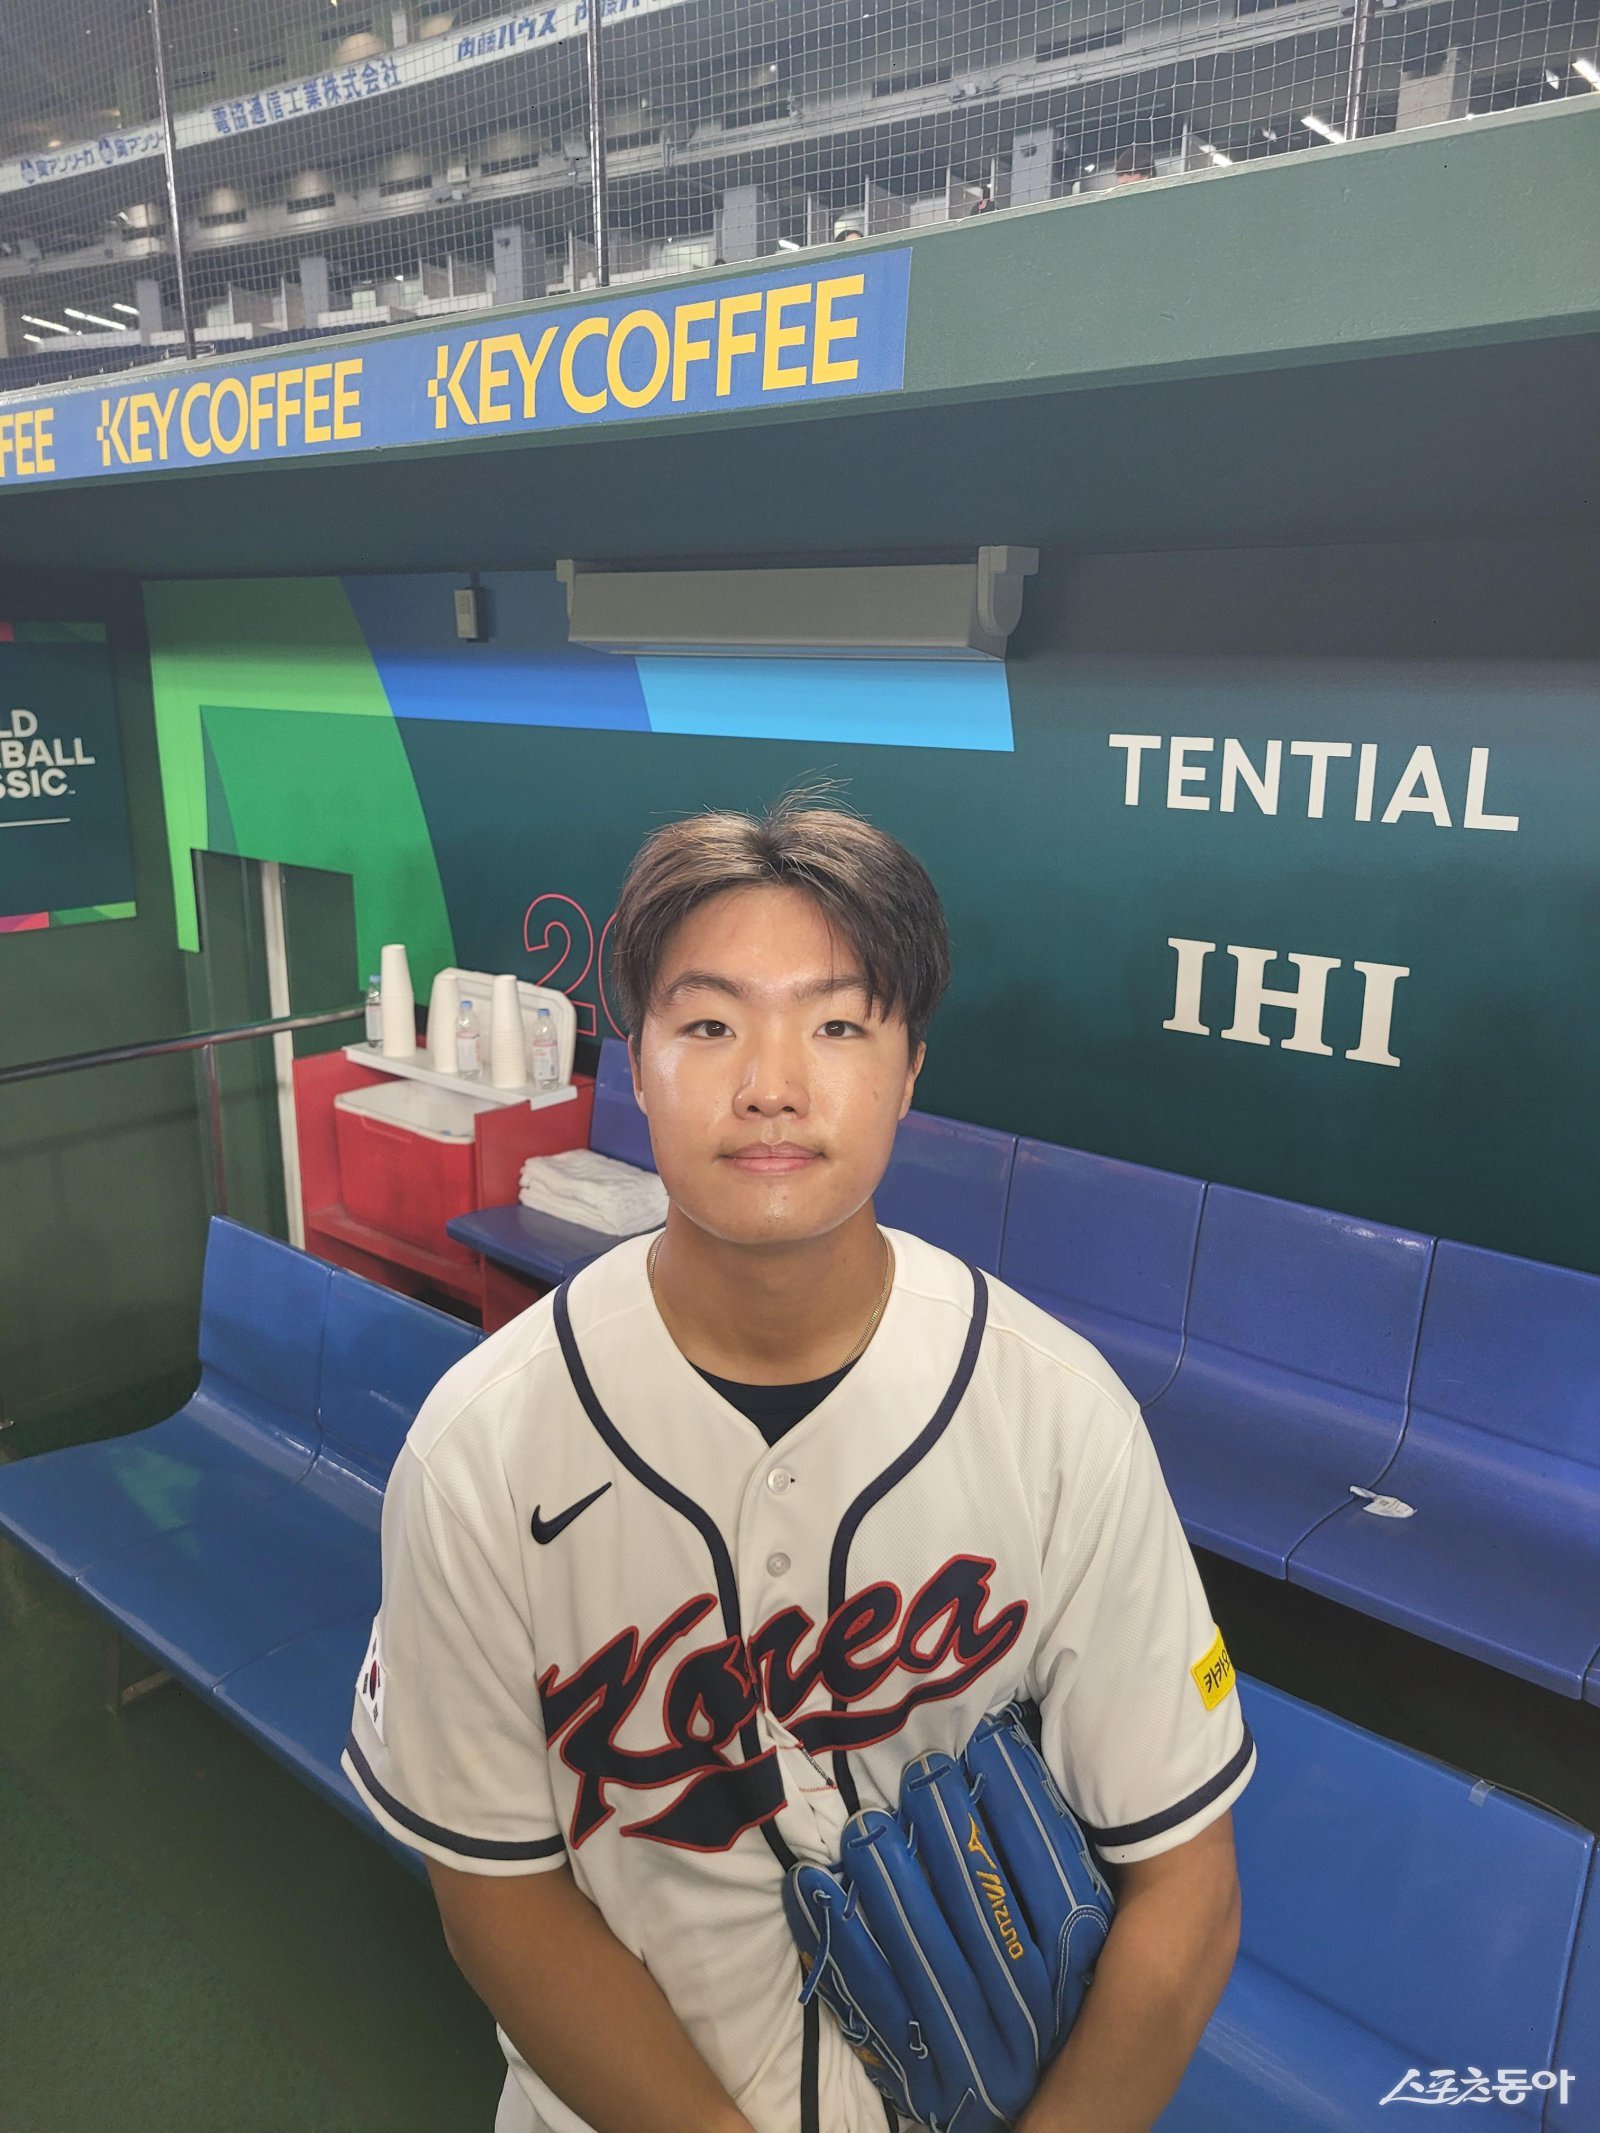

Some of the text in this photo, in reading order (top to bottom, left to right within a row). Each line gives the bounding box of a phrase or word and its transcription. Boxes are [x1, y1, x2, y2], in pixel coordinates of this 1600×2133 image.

[457, 8, 557, 61] 内藤ハウス
[0, 737, 96, 769] BALL
[1108, 733, 1519, 832] TENTIAL
[1162, 937, 1410, 1068] IHI
[539, 1553, 1028, 1851] Korea
